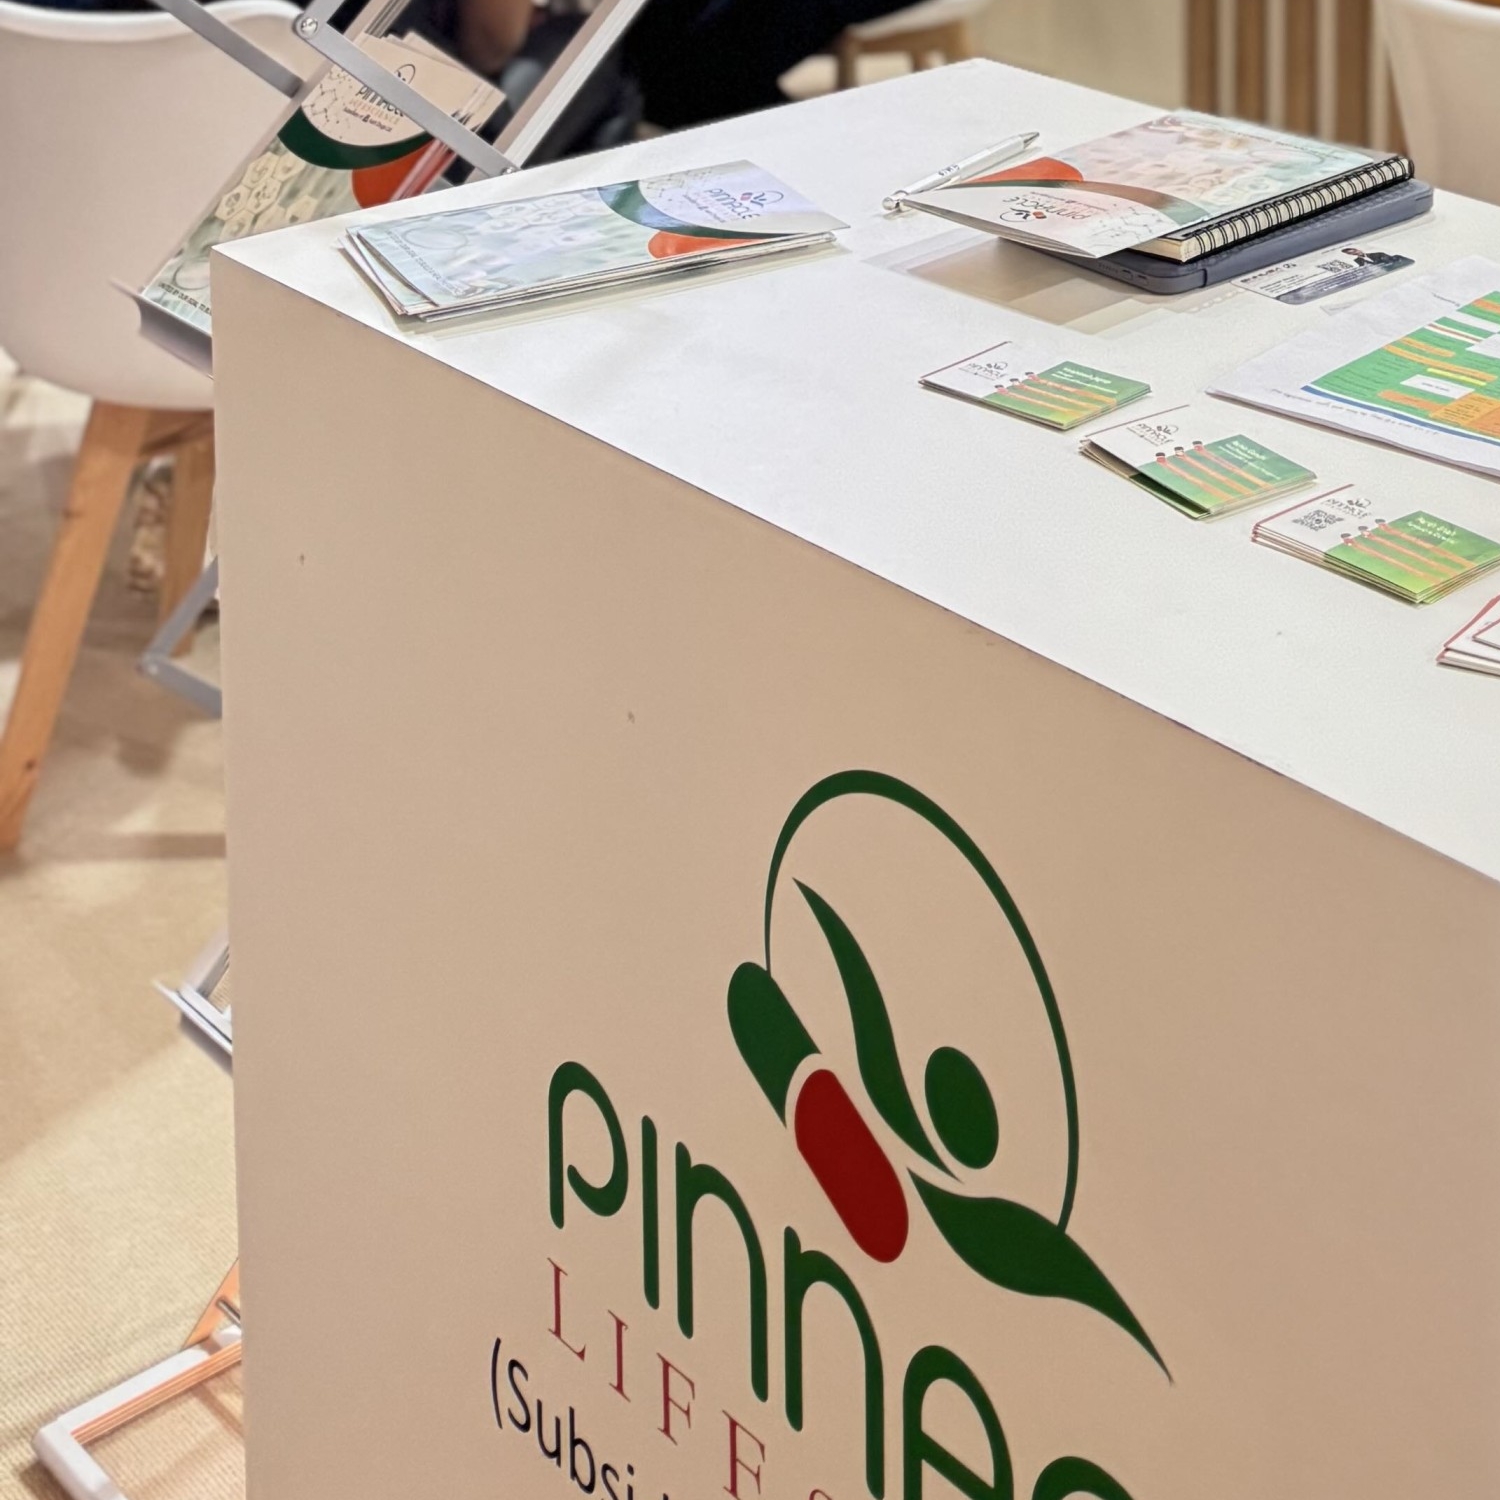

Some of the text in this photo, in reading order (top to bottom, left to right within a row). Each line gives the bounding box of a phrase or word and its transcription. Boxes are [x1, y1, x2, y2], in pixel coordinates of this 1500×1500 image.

[546, 1257, 845, 1500] LIFE
[548, 1060, 1135, 1500] PINNA
[490, 1337, 670, 1500] (Subsi
